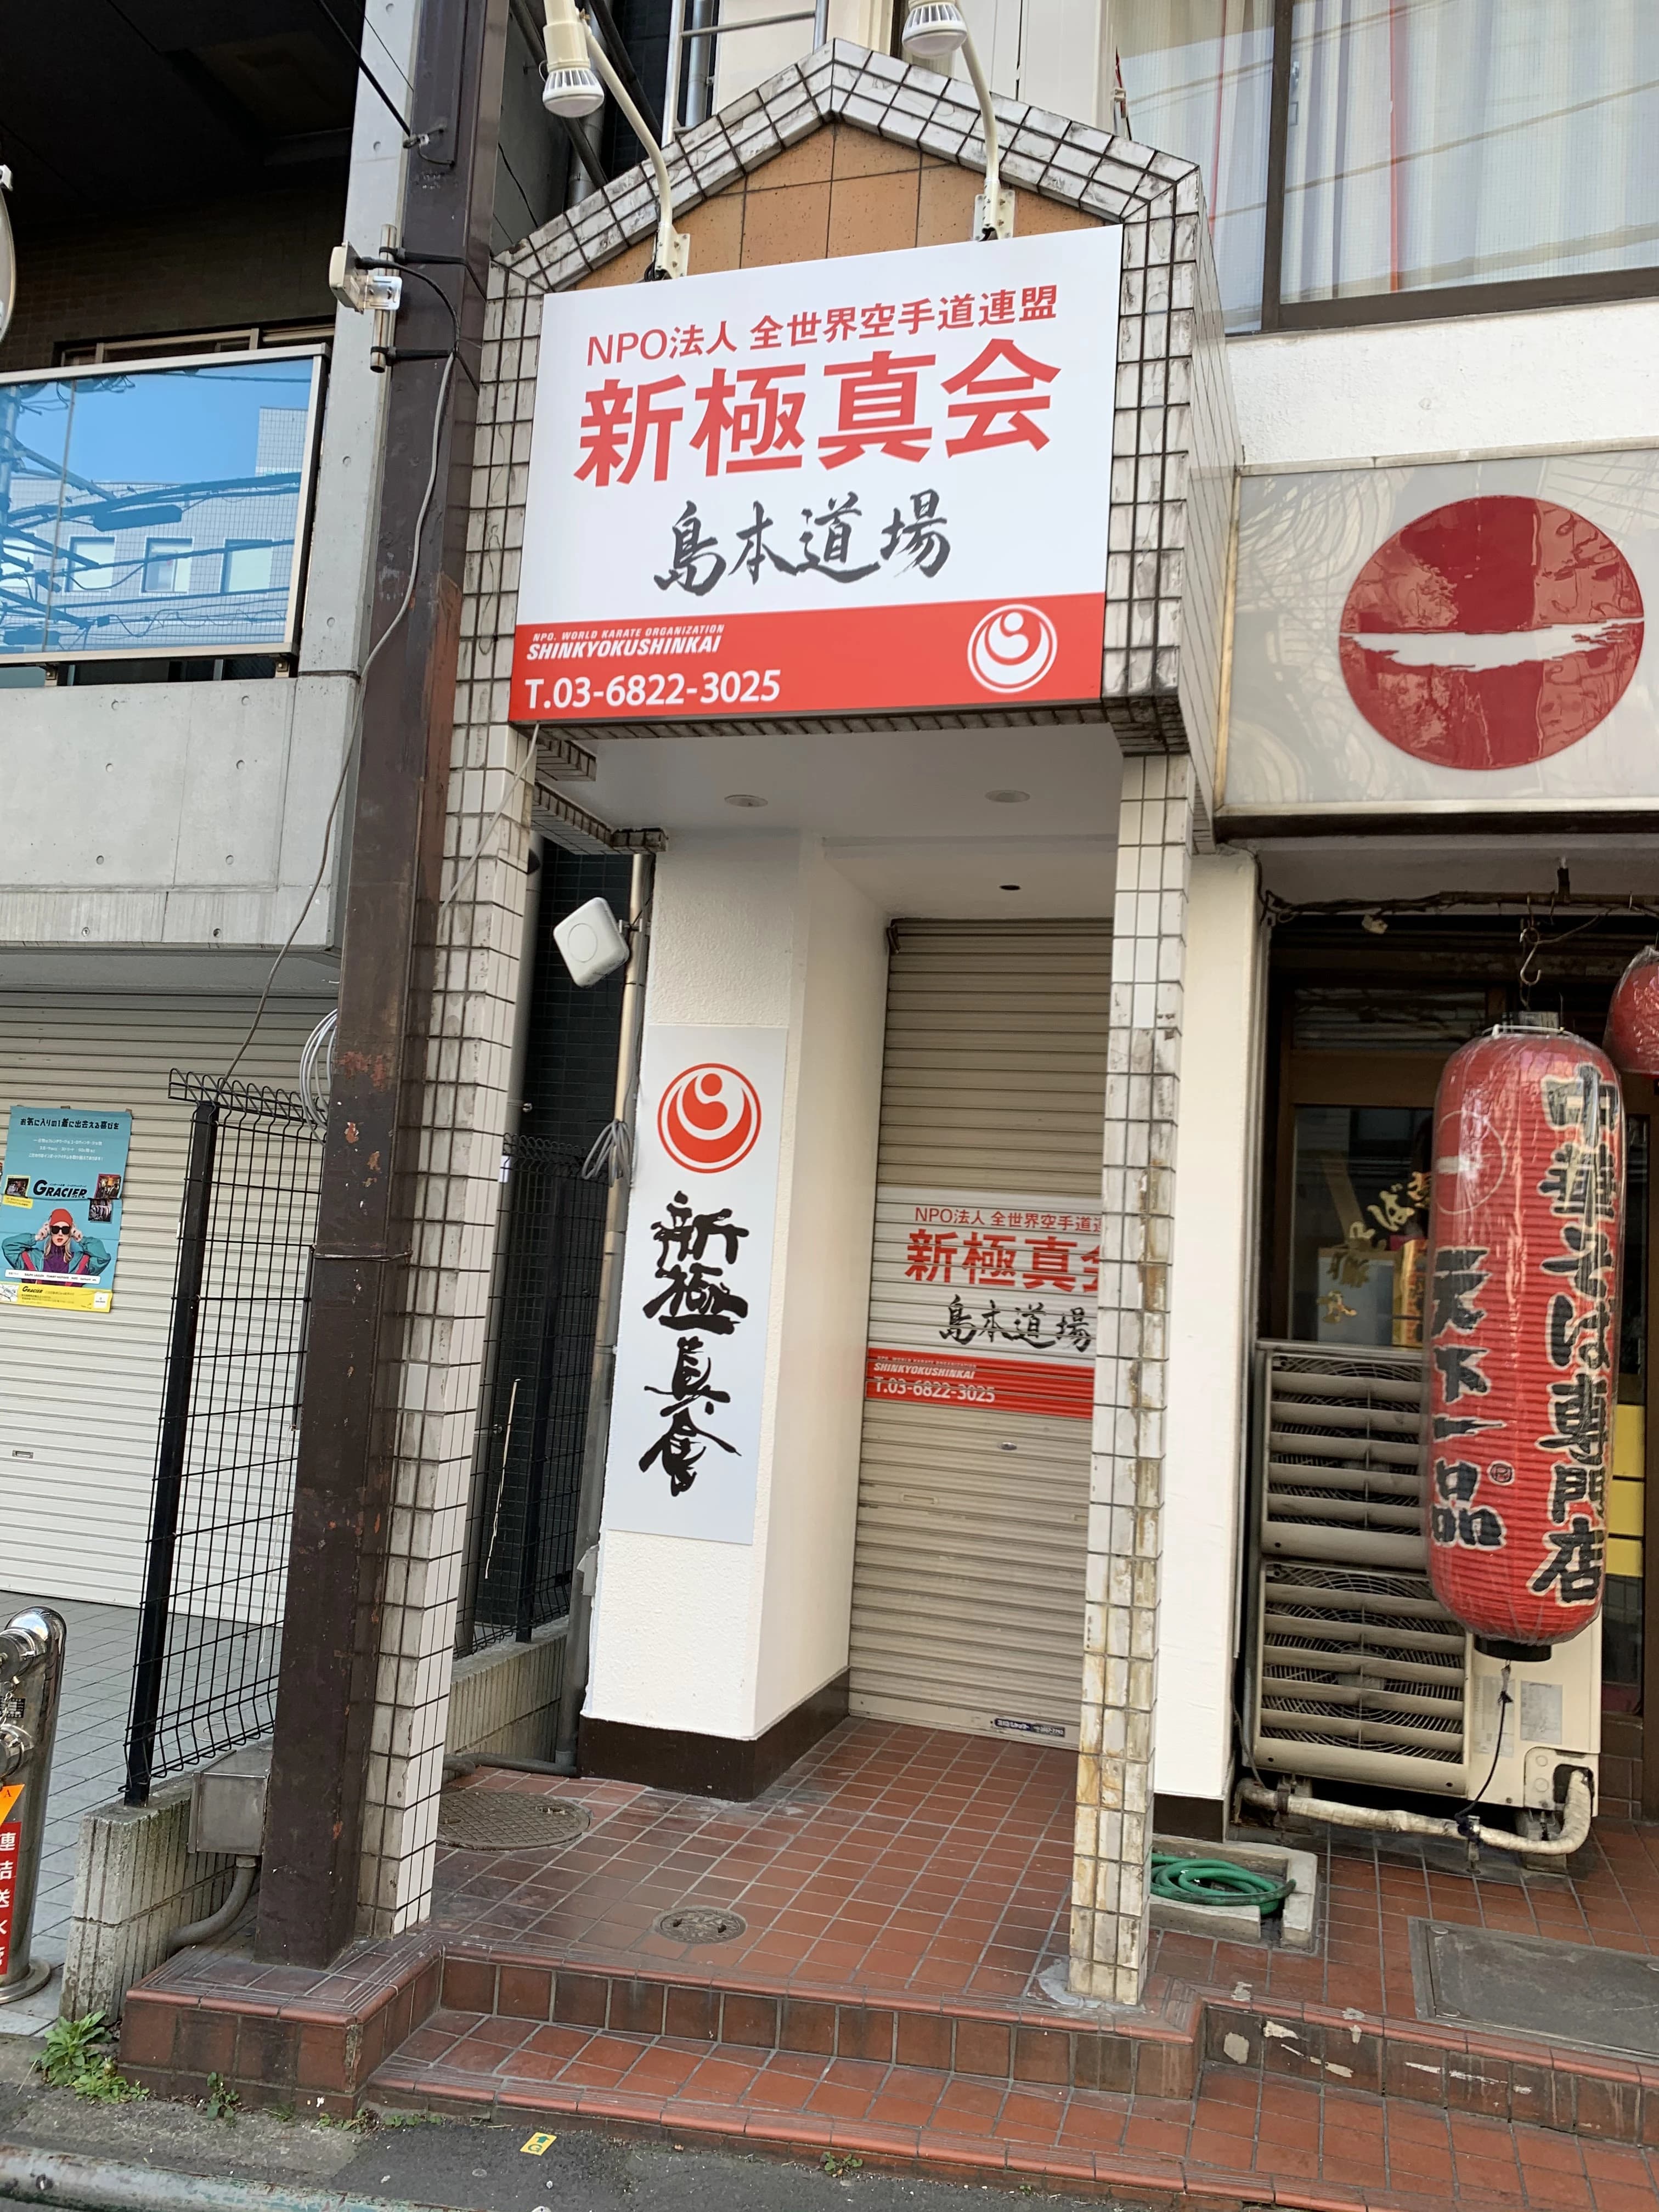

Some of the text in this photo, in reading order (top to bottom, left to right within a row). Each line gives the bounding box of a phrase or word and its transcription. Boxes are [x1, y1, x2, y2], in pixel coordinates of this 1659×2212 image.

[587, 285, 1057, 366] NPO法人 全世界空手道連盟
[574, 338, 1061, 487] 新極真会
[654, 488, 951, 596] 島本道場
[527, 635, 721, 661] SHINKYOKUSHINKAI
[562, 630, 597, 639] WORLD
[601, 628, 641, 638] KARATE
[645, 624, 724, 637] ORGANIZATION
[525, 669, 781, 709] T.03-6822-3025
[915, 1207, 985, 1225] NPO法人
[939, 1294, 1097, 1353] 島本道場
[873, 1362, 975, 1379] SHINKYOKUSHINKAI
[873, 1376, 995, 1403] T.03-6822-3025
